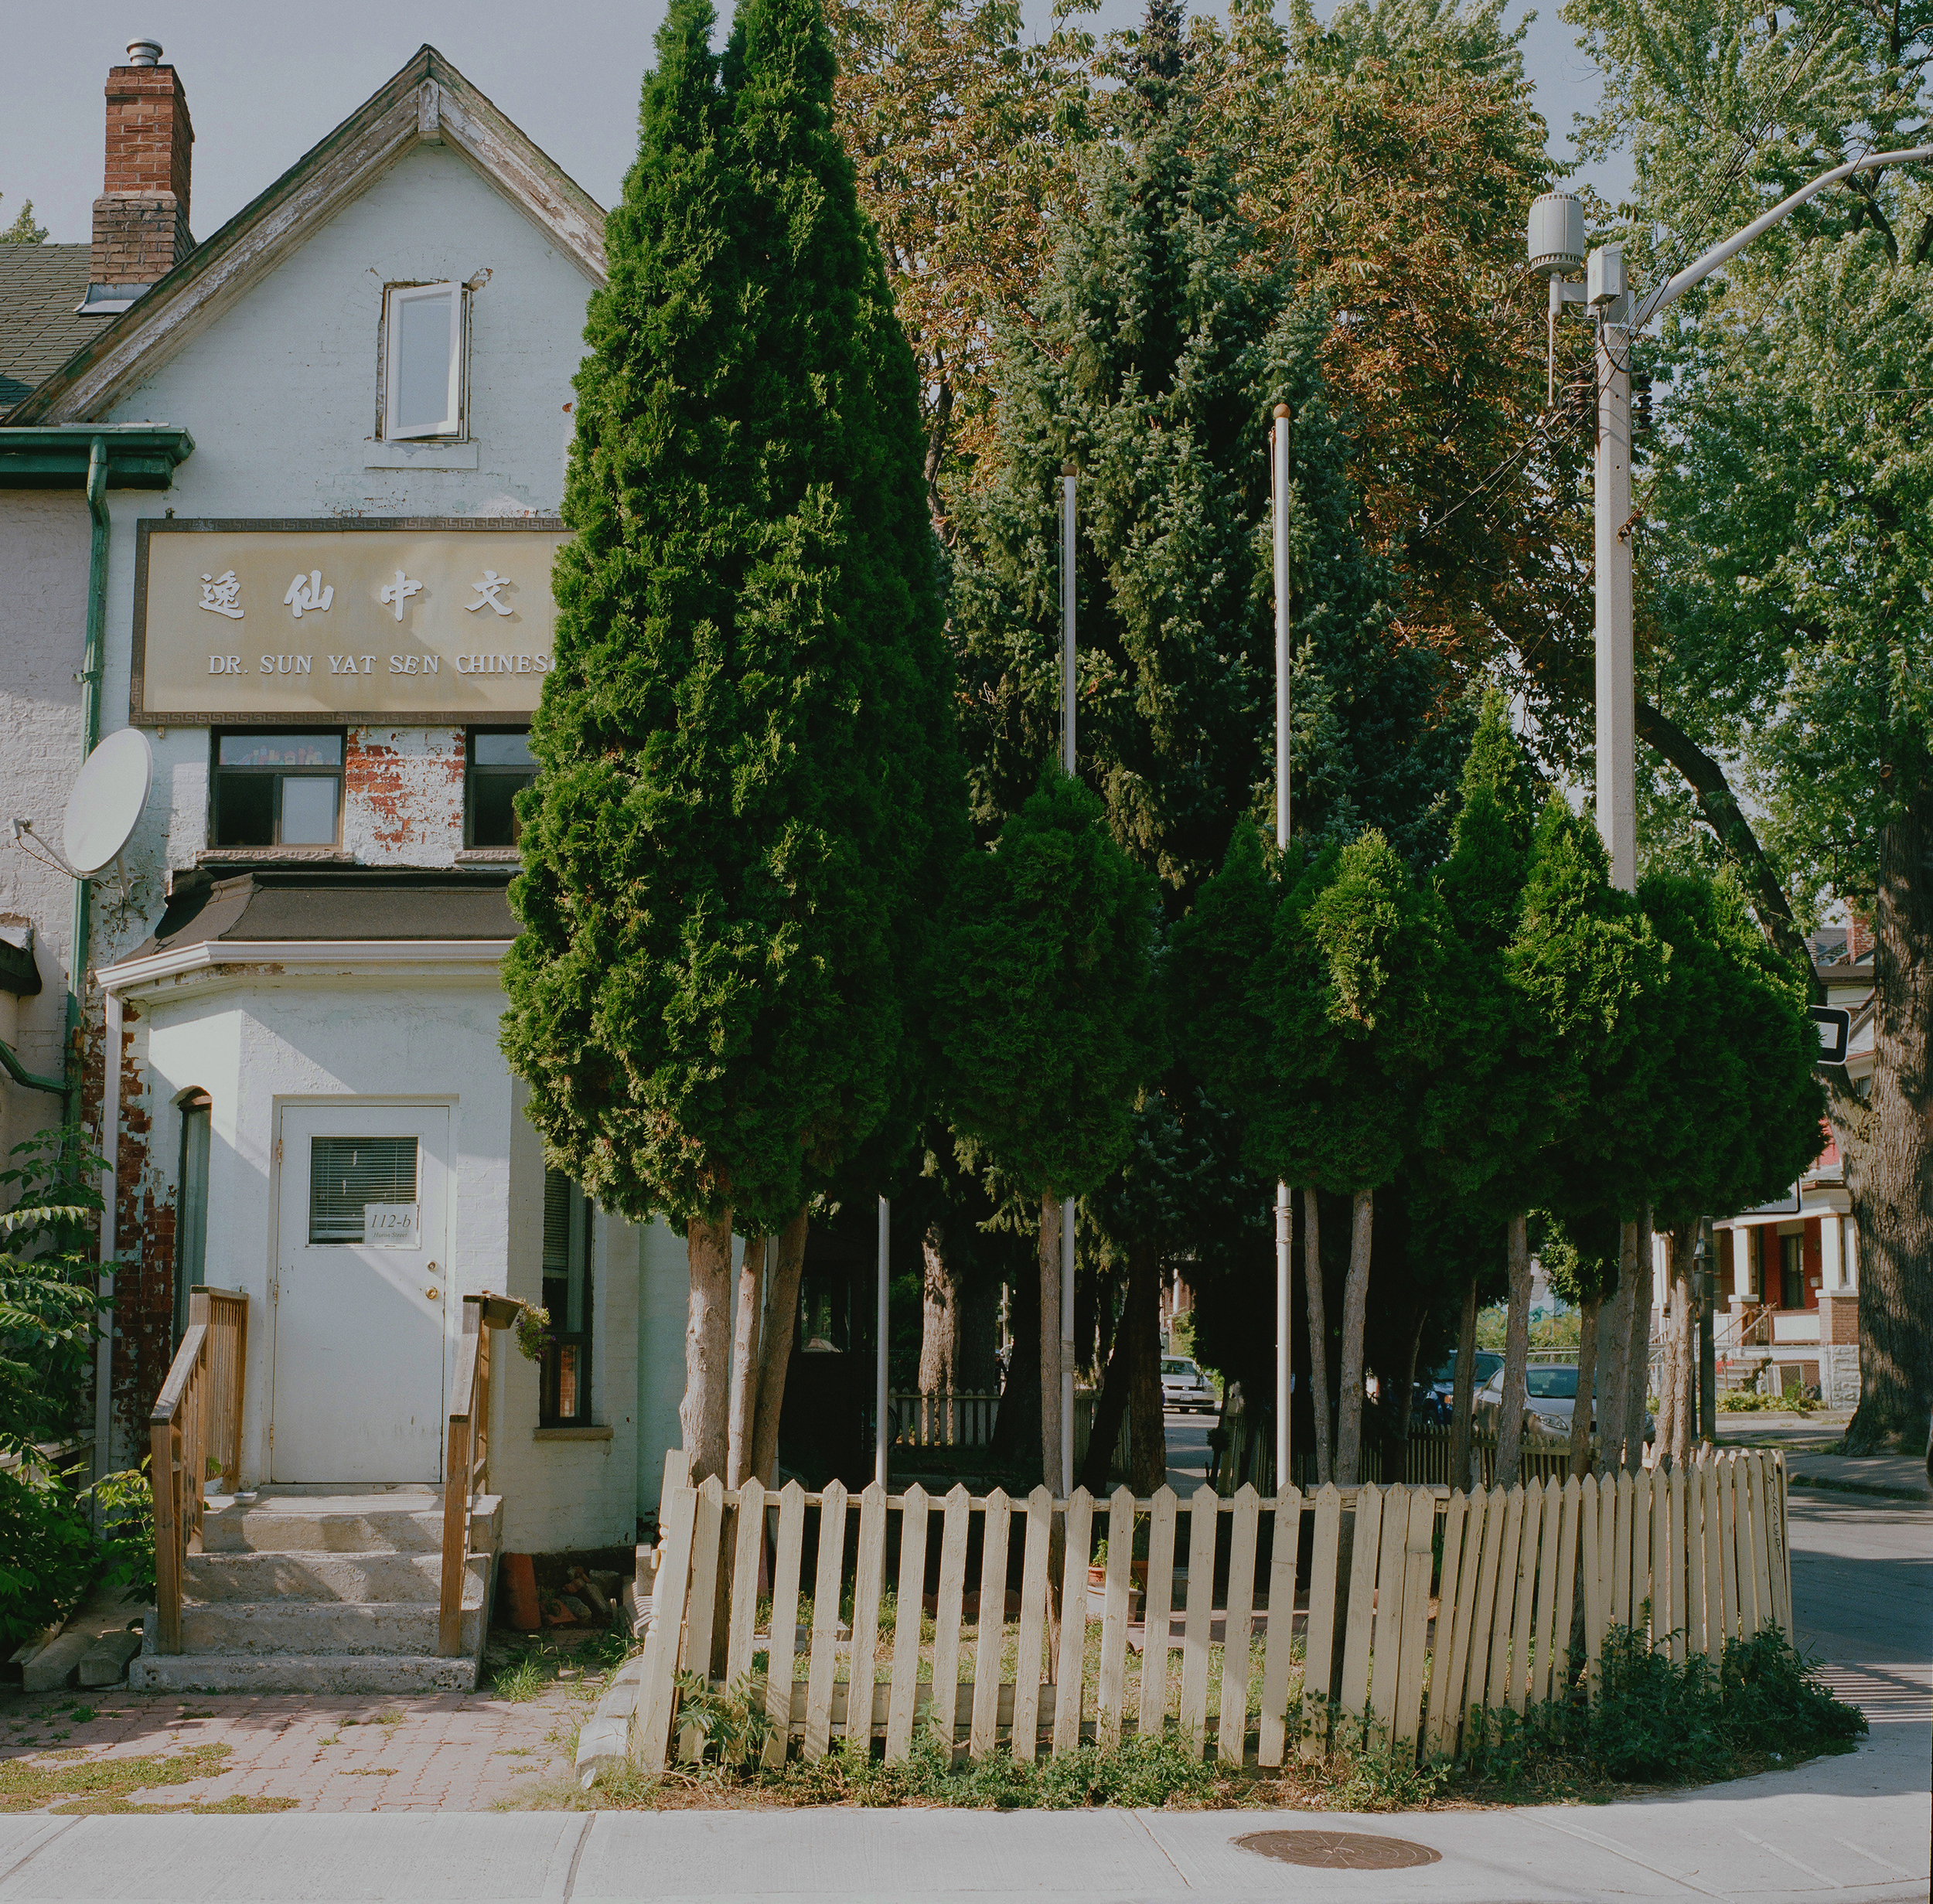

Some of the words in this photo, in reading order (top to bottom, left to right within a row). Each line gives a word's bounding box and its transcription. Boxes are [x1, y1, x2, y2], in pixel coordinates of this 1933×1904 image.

[199, 570, 514, 622] 逸仙中文
[208, 656, 248, 674] DR.
[260, 655, 312, 674] SUN
[327, 656, 377, 674] YAT
[388, 654, 440, 676] SEN
[371, 1214, 411, 1228] 112-b
